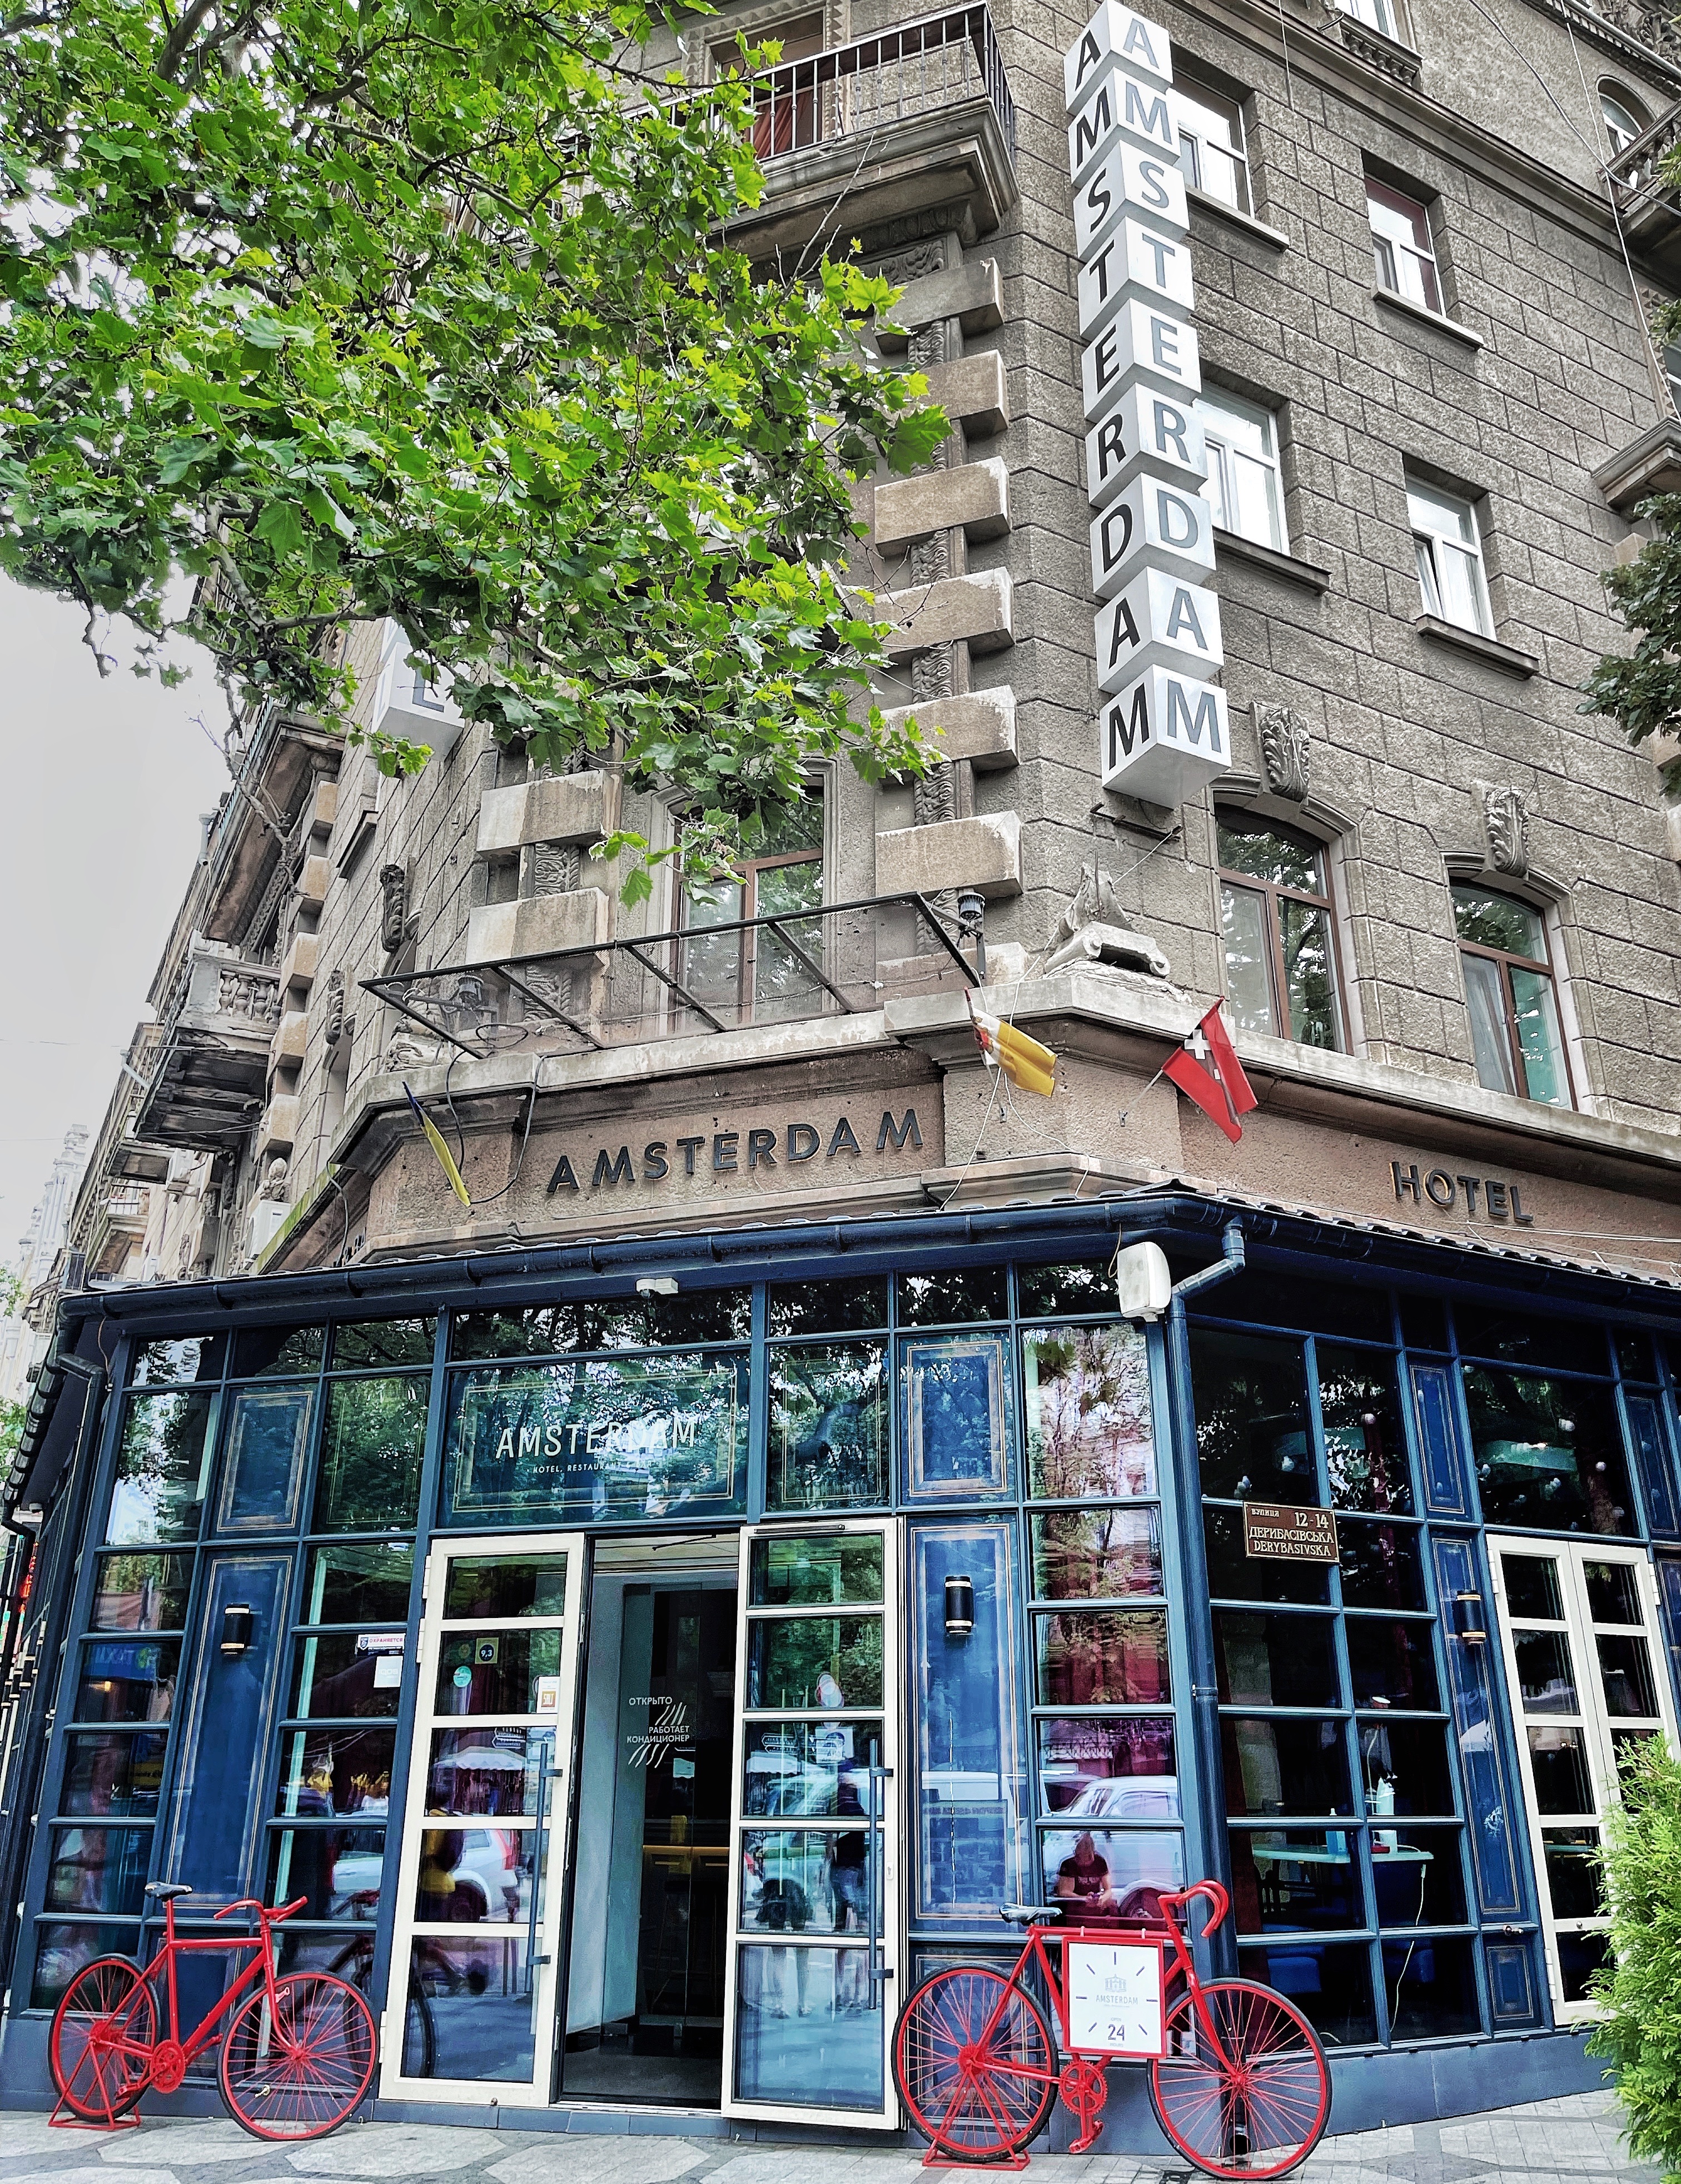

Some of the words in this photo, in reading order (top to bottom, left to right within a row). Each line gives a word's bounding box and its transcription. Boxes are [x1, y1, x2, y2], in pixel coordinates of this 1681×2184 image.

[1122, 18, 1222, 755] AMSTERDAM
[1075, 29, 1150, 771] AMSTERDAM
[546, 1108, 924, 1193] AMSTERDAM
[1389, 1161, 1534, 1222] HOTEL
[495, 1417, 696, 1460] AMSTERDAM
[533, 1466, 563, 1474] HOTEL,
[567, 1461, 621, 1472] RESTAURANT
[1249, 1526, 1335, 1543] ДЕРИБАСІВСЬКА
[1254, 1540, 1332, 1556] DERYBASIVSKA
[481, 1649, 493, 1658] 9,3
[629, 1696, 673, 1705] ОТКРЫТО
[649, 1725, 690, 1734] РАБОТАЕТ
[626, 1734, 690, 1744] КОНДИЦИОНЕР
[1096, 1994, 1138, 2005] AMSTERDAM
[1108, 2024, 1125, 2041] 24
